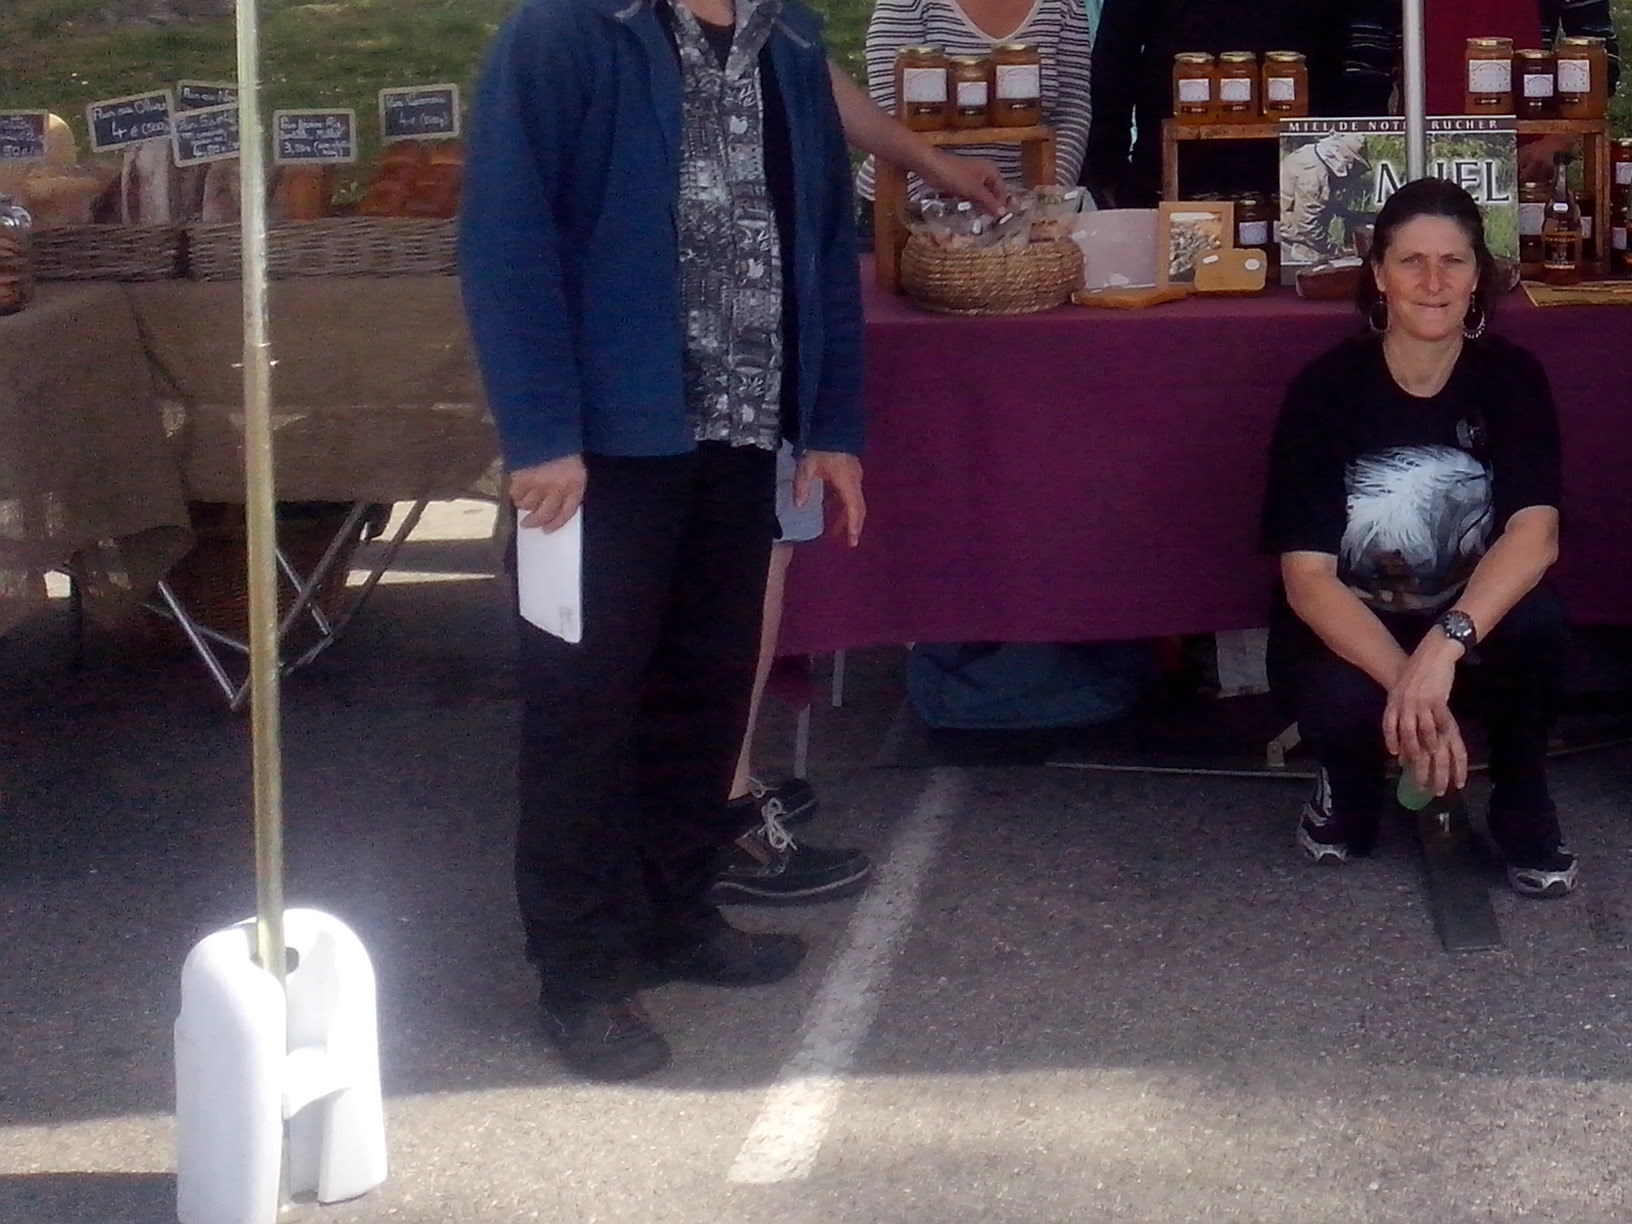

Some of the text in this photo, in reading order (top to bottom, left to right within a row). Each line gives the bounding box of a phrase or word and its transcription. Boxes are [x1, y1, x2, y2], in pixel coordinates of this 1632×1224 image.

[1288, 119, 1498, 132] MIEL DE NOT RUCHER
